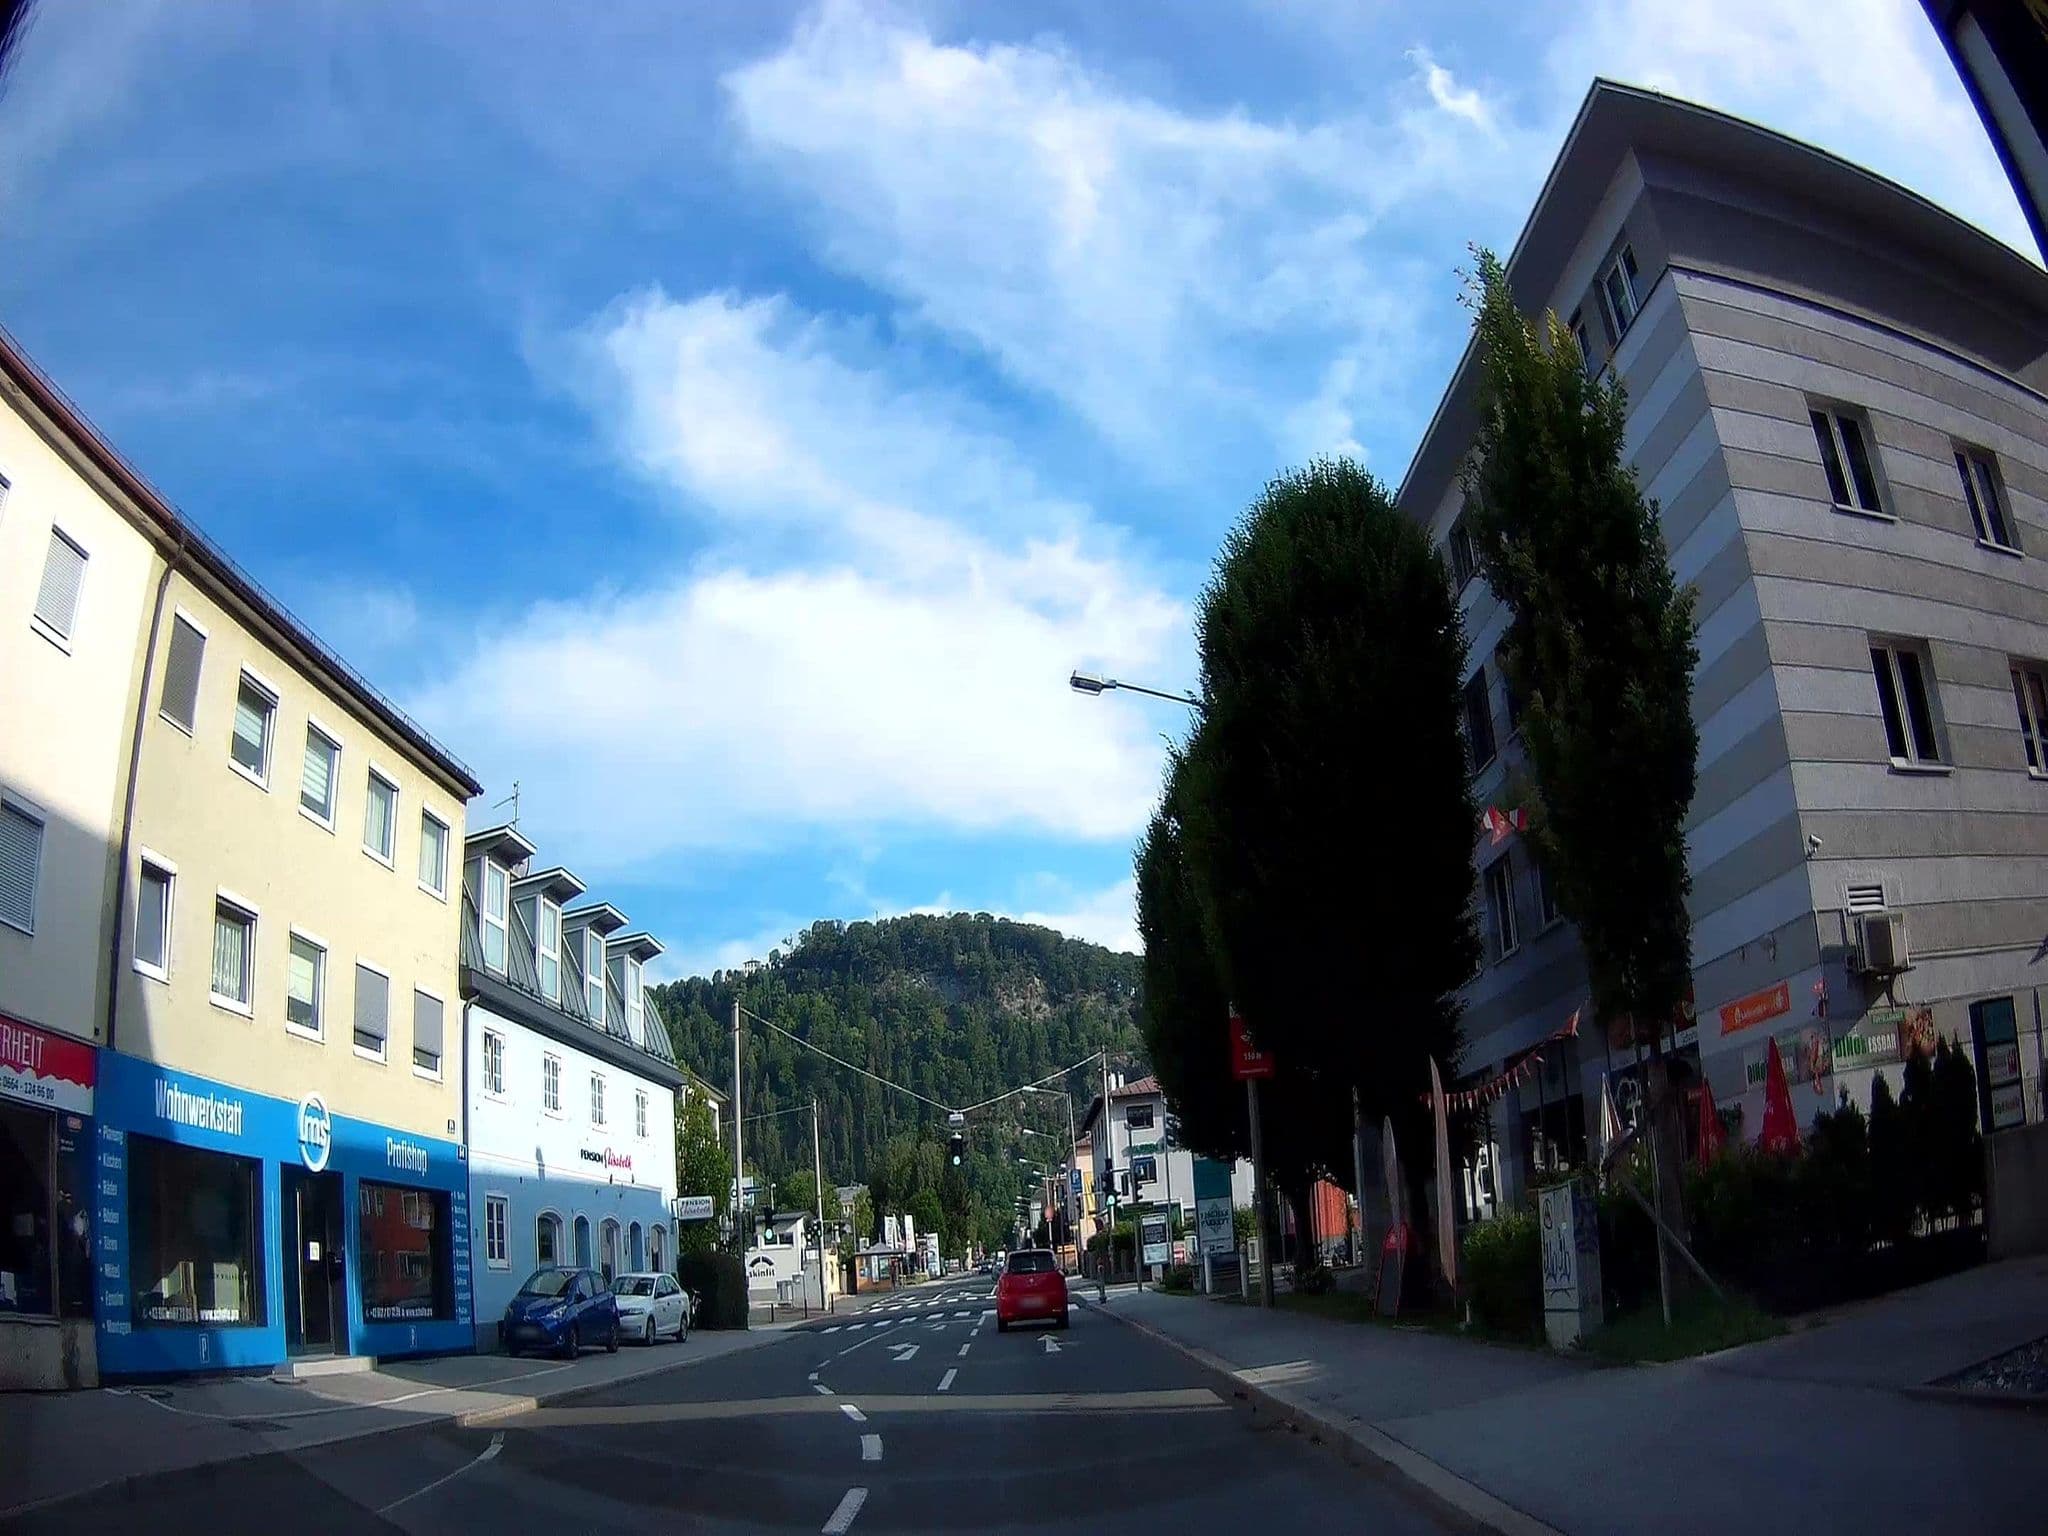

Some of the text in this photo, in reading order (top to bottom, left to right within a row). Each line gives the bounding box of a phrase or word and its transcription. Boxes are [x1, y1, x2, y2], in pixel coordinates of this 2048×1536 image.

[0, 1024, 45, 1069] RHEIT
[155, 1078, 243, 1137] Wohnwerkstatt
[386, 1136, 428, 1177] Profishop
[580, 1148, 604, 1165] PENSION
[681, 1199, 711, 1207] PENSION
[748, 1267, 776, 1279] skinfit
